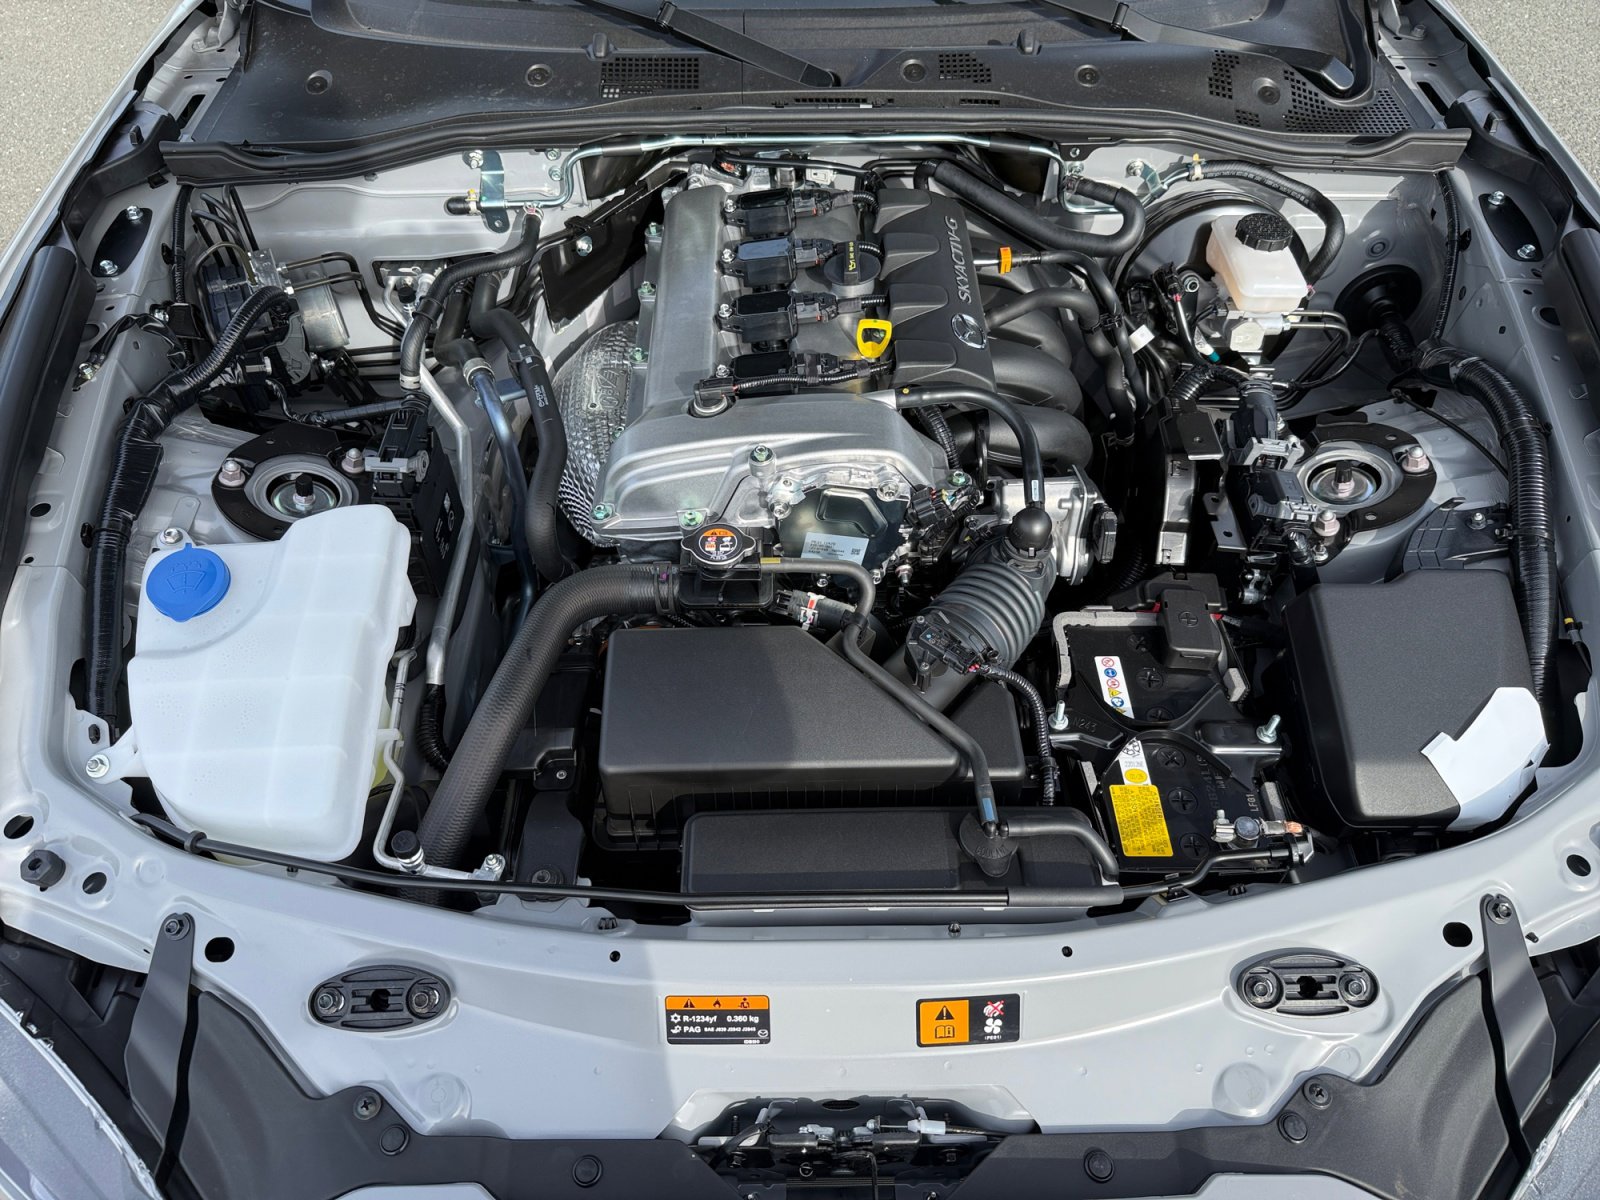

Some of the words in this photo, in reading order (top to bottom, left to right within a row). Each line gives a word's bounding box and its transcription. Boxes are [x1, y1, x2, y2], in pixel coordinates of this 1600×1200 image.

[945, 215, 972, 305] SKYACTIV-G
[683, 1015, 717, 1023] R-1234yf
[749, 1015, 759, 1023] kg
